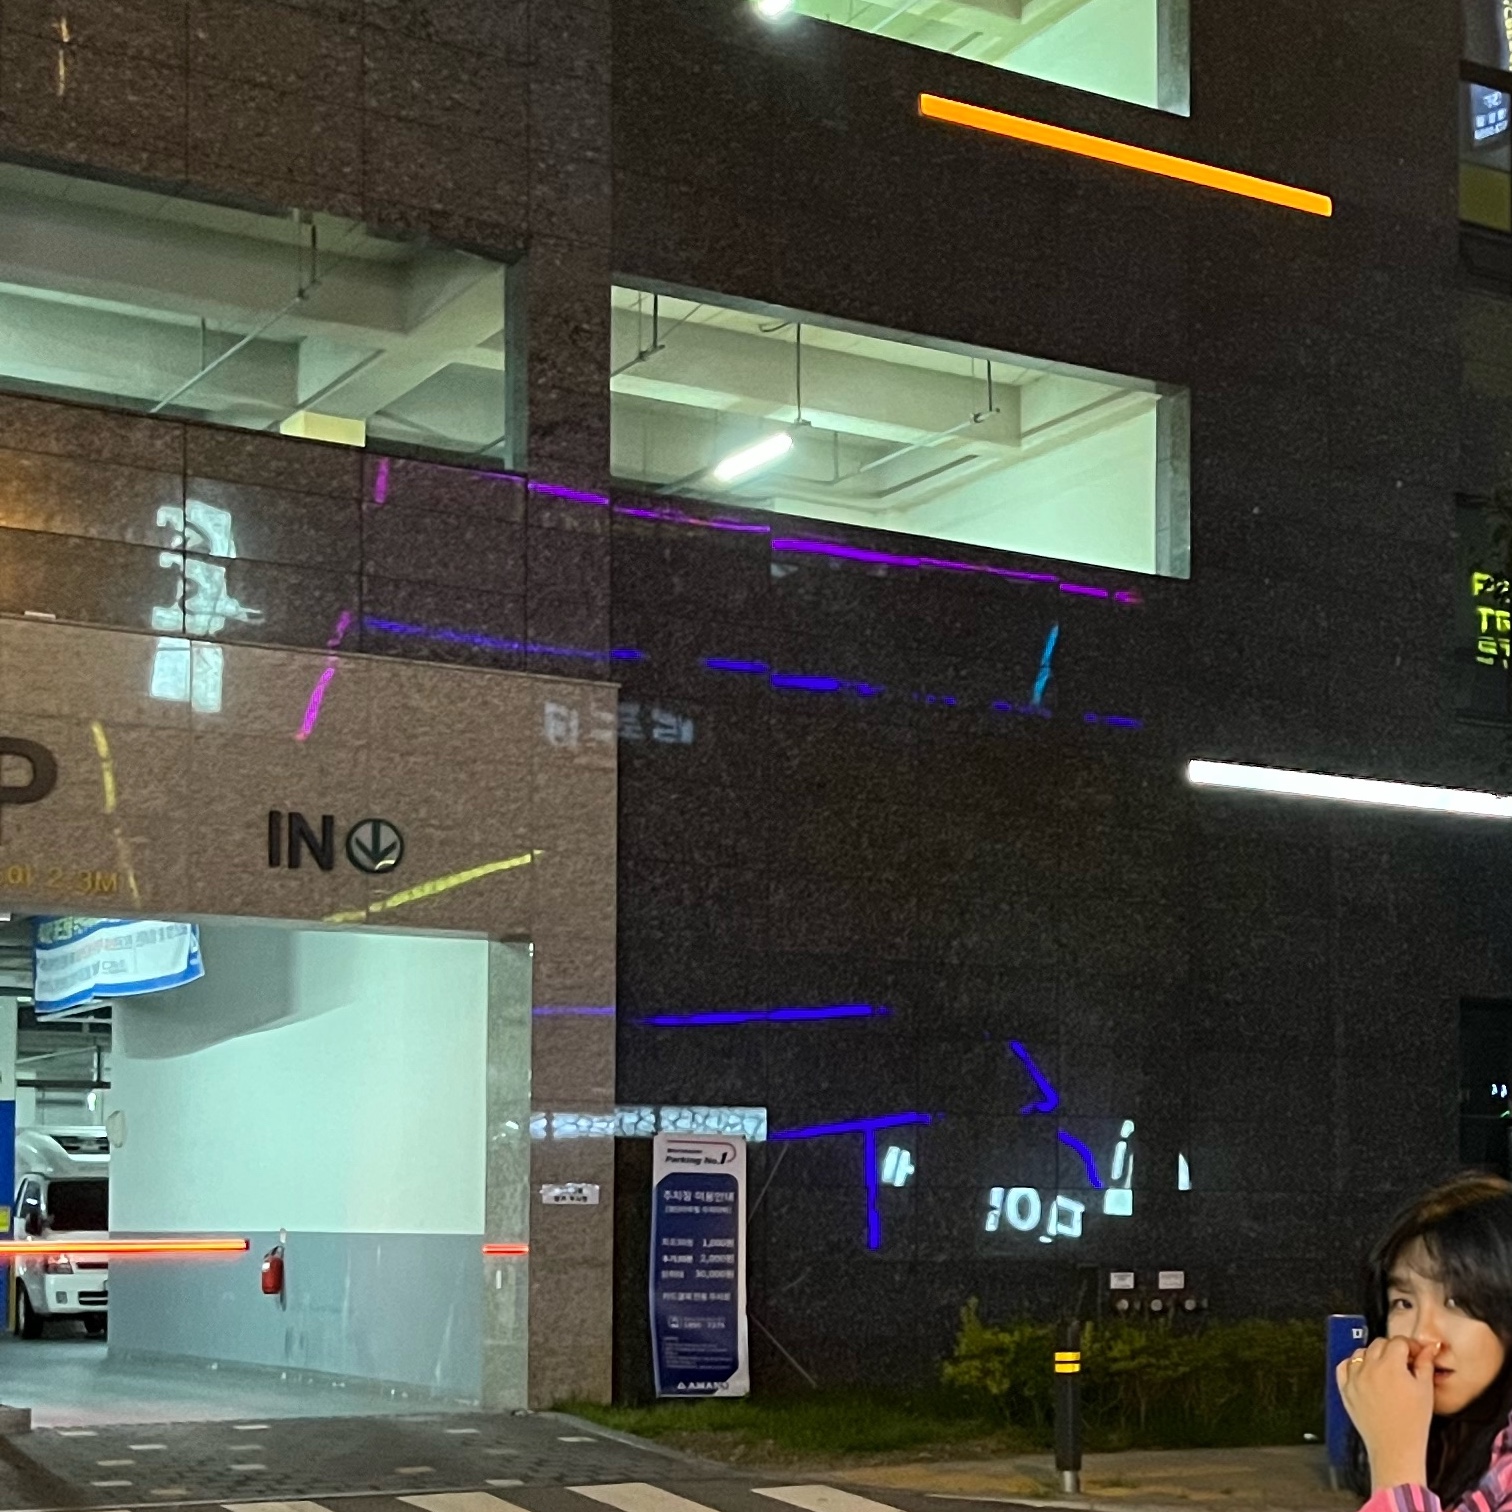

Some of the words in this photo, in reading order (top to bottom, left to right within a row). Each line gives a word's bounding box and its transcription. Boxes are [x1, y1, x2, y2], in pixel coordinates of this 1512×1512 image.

[268, 811, 335, 871] IN
[665, 1155, 702, 1166] Parking
[687, 1382, 730, 1390] AMANO
